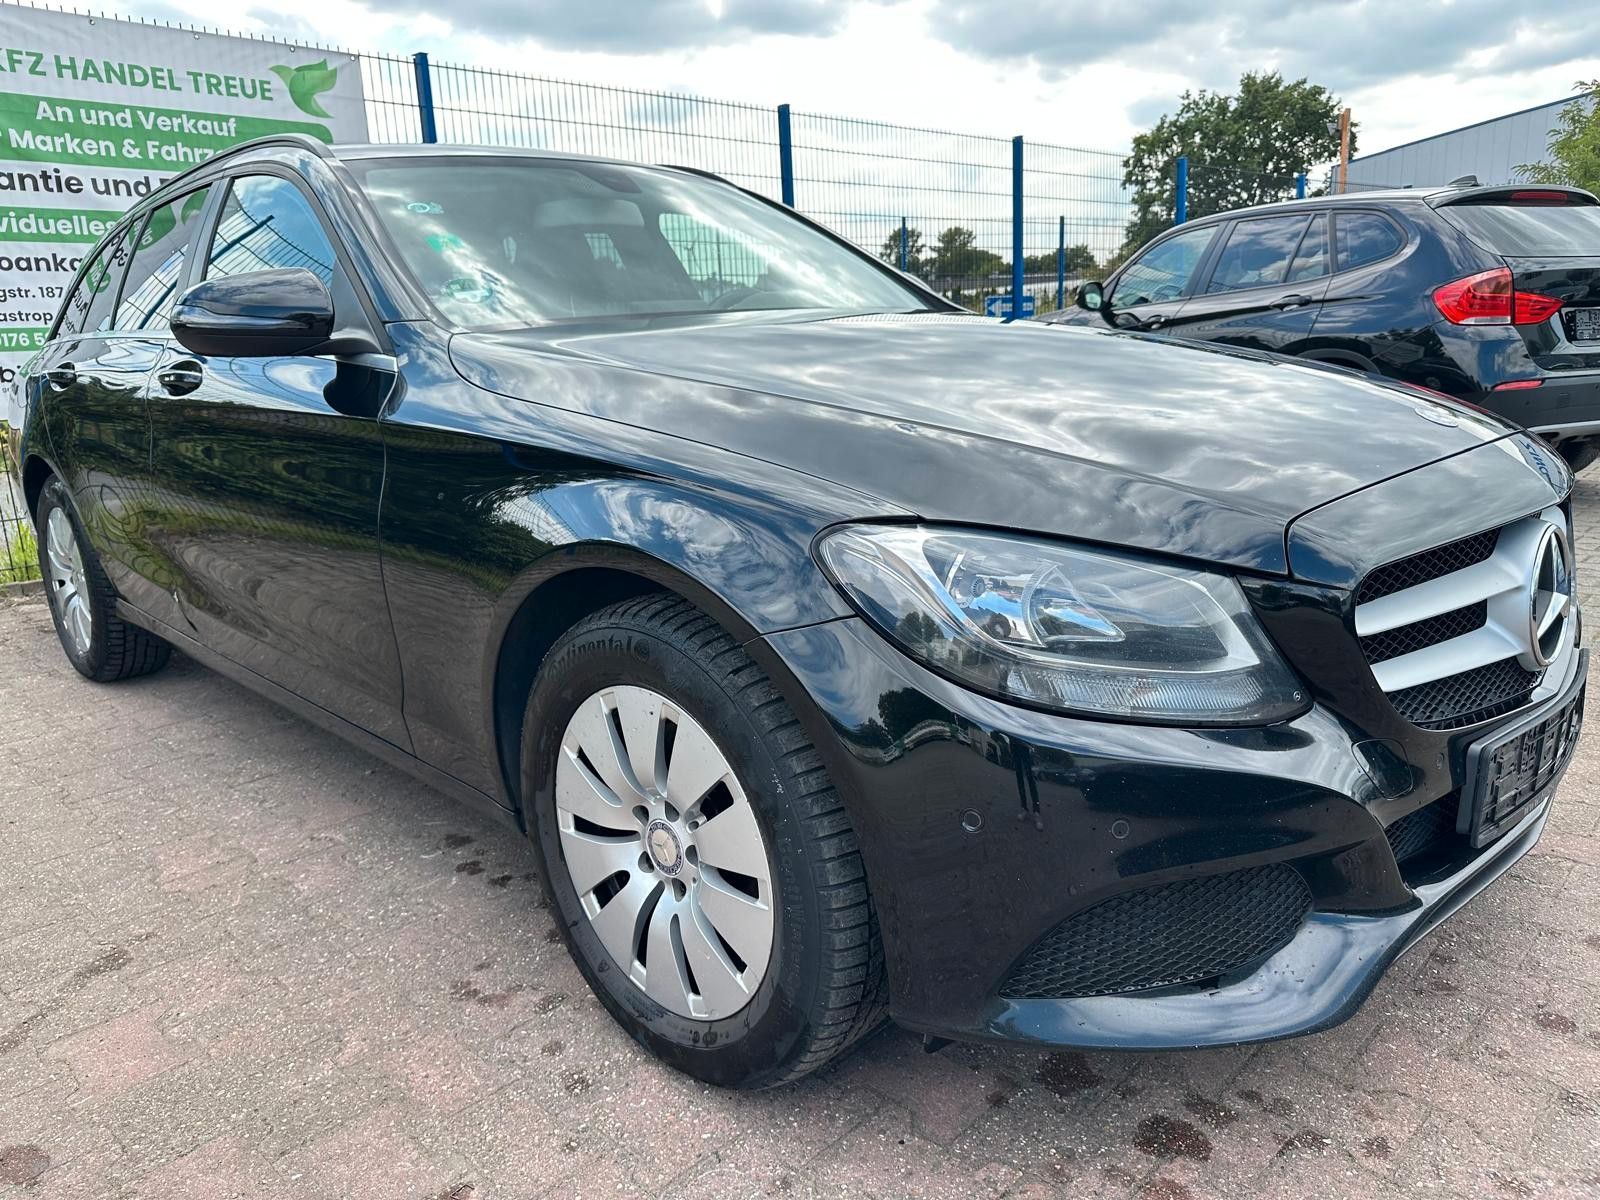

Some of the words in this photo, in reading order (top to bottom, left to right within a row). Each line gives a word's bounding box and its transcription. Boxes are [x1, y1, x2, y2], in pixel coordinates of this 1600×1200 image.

[54, 54, 182, 92] HANDEL
[186, 70, 274, 101] TREUE
[35, 100, 74, 123] An
[79, 107, 133, 129] und
[136, 110, 237, 138] Verkauf
[7, 127, 116, 158] Marken
[122, 138, 143, 160] &
[0, 167, 84, 194] antie
[91, 176, 152, 199] und
[38, 286, 64, 299] 187
[0, 310, 53, 325] astrop
[0, 332, 30, 347] 176
